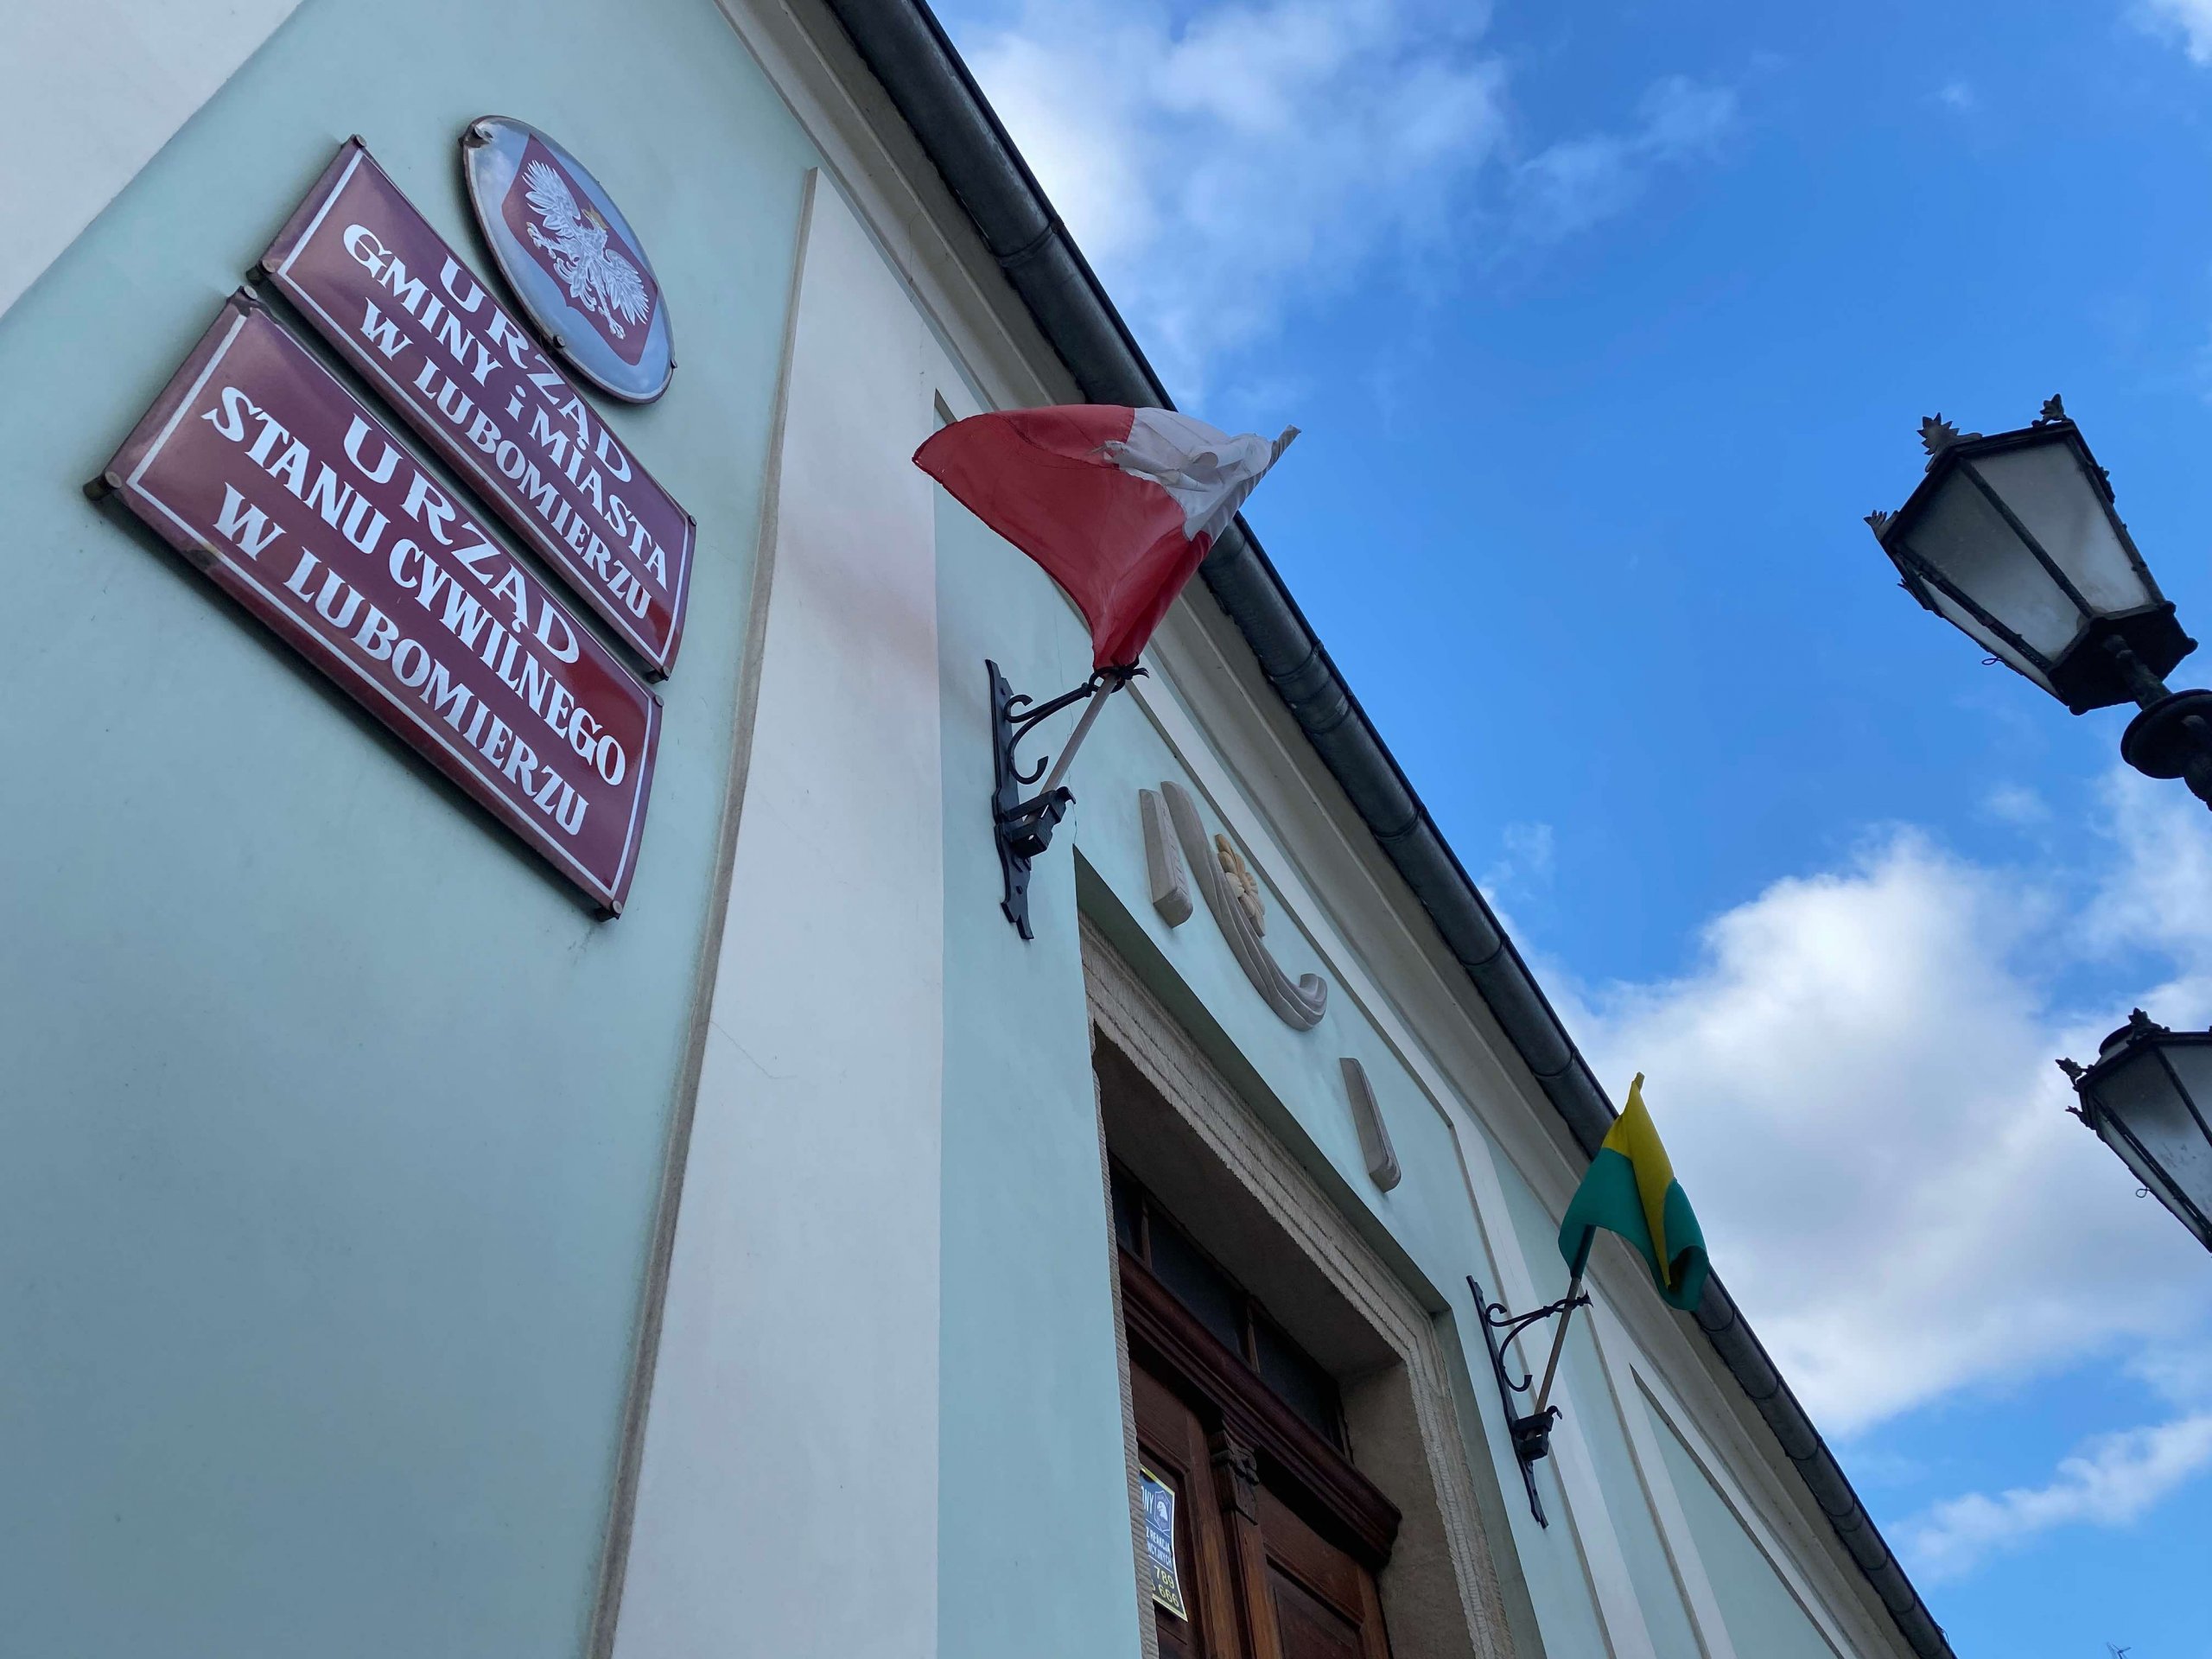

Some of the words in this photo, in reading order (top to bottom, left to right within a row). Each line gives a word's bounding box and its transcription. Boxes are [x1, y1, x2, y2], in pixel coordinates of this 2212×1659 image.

[343, 224, 503, 387] GMINY
[528, 404, 668, 592] MIASTA
[359, 297, 413, 361] W
[413, 355, 653, 620] LUBOMIERZU
[440, 254, 632, 484] URZĄD
[200, 386, 391, 554] STANU
[389, 538, 626, 785] CYWILNEGO
[213, 481, 287, 562] W
[283, 546, 589, 836] LUBOMIERZU
[343, 413, 580, 664] URZĄD
[1154, 1565, 1174, 1589] 789
[1158, 1584, 1179, 1607] 666
